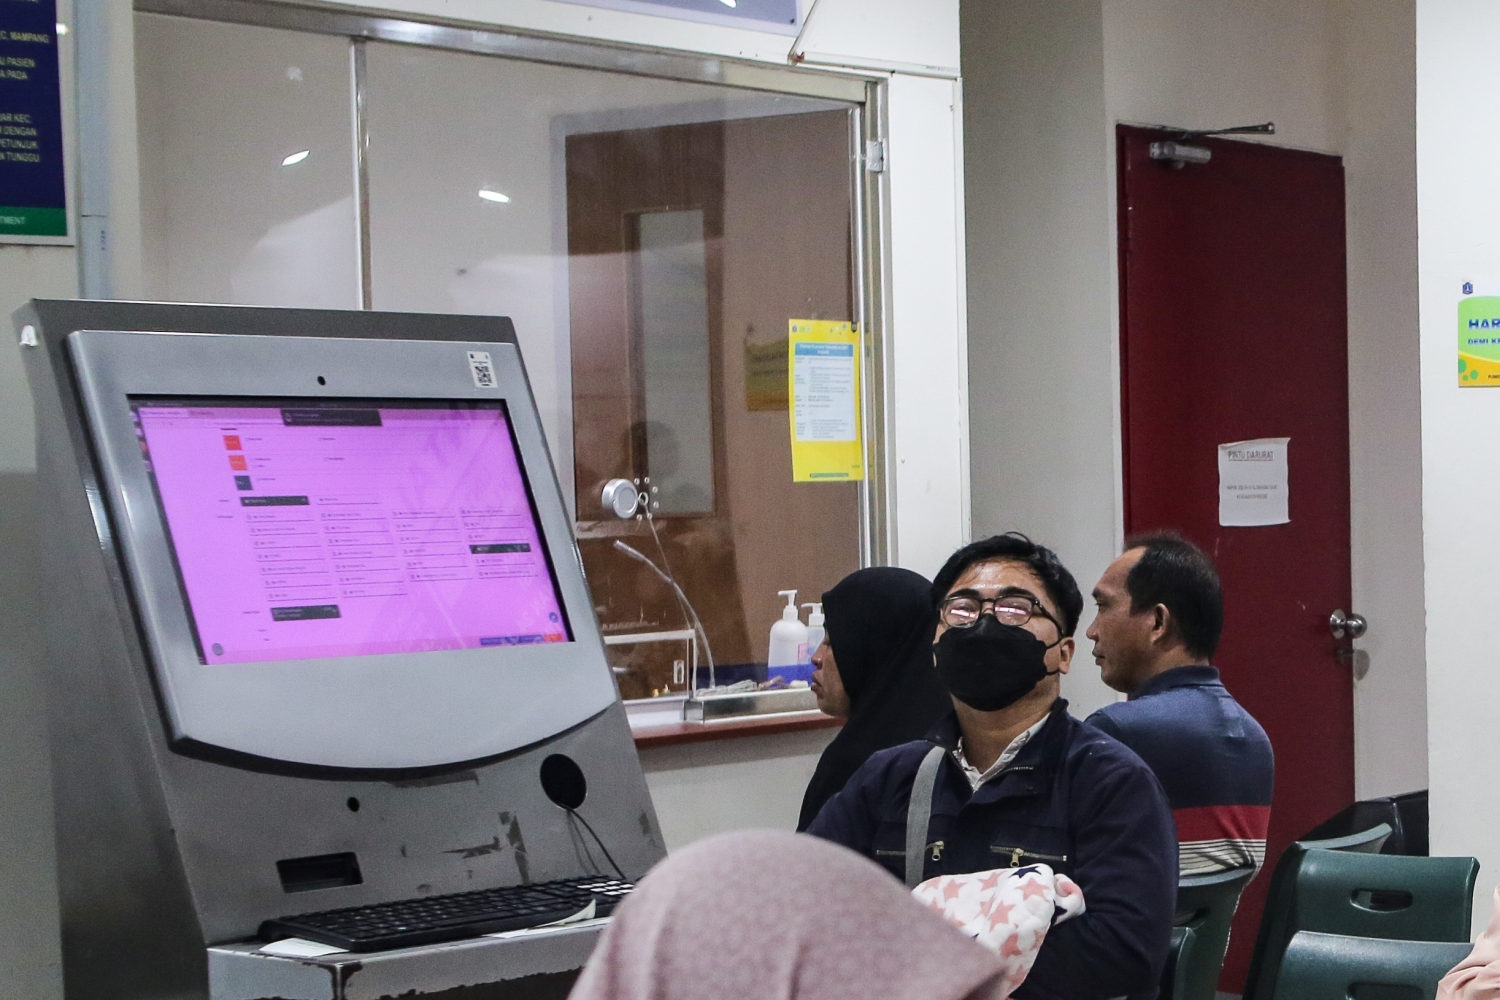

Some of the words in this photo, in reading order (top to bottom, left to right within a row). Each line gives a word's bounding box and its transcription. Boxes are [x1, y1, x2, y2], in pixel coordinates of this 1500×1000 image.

[10, 31, 49, 43] MAMPANG
[7, 57, 35, 67] PASIEN
[6, 152, 40, 162] TUNGGU
